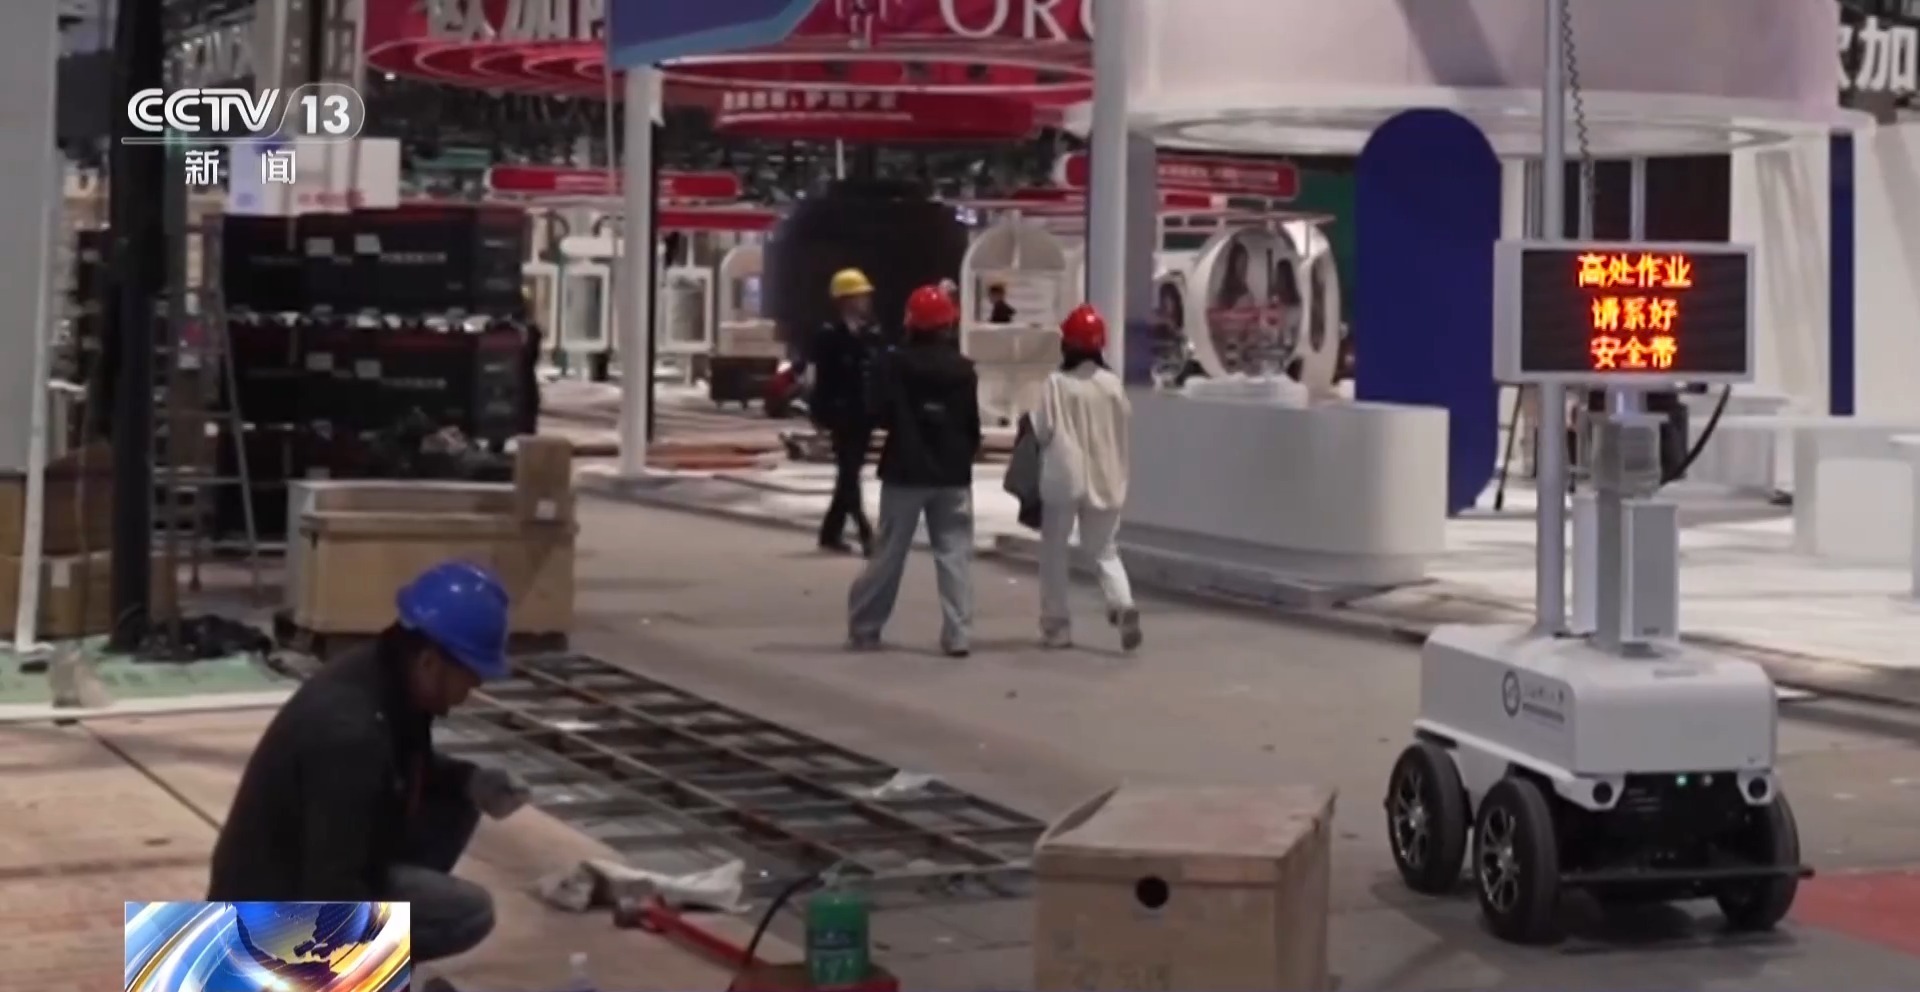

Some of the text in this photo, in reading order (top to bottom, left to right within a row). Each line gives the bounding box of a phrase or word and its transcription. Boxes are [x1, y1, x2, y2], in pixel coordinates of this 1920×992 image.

[1577, 253, 1692, 288] 高处作业
[1591, 297, 1678, 331] 请系好
[1590, 335, 1678, 370] 安全带
